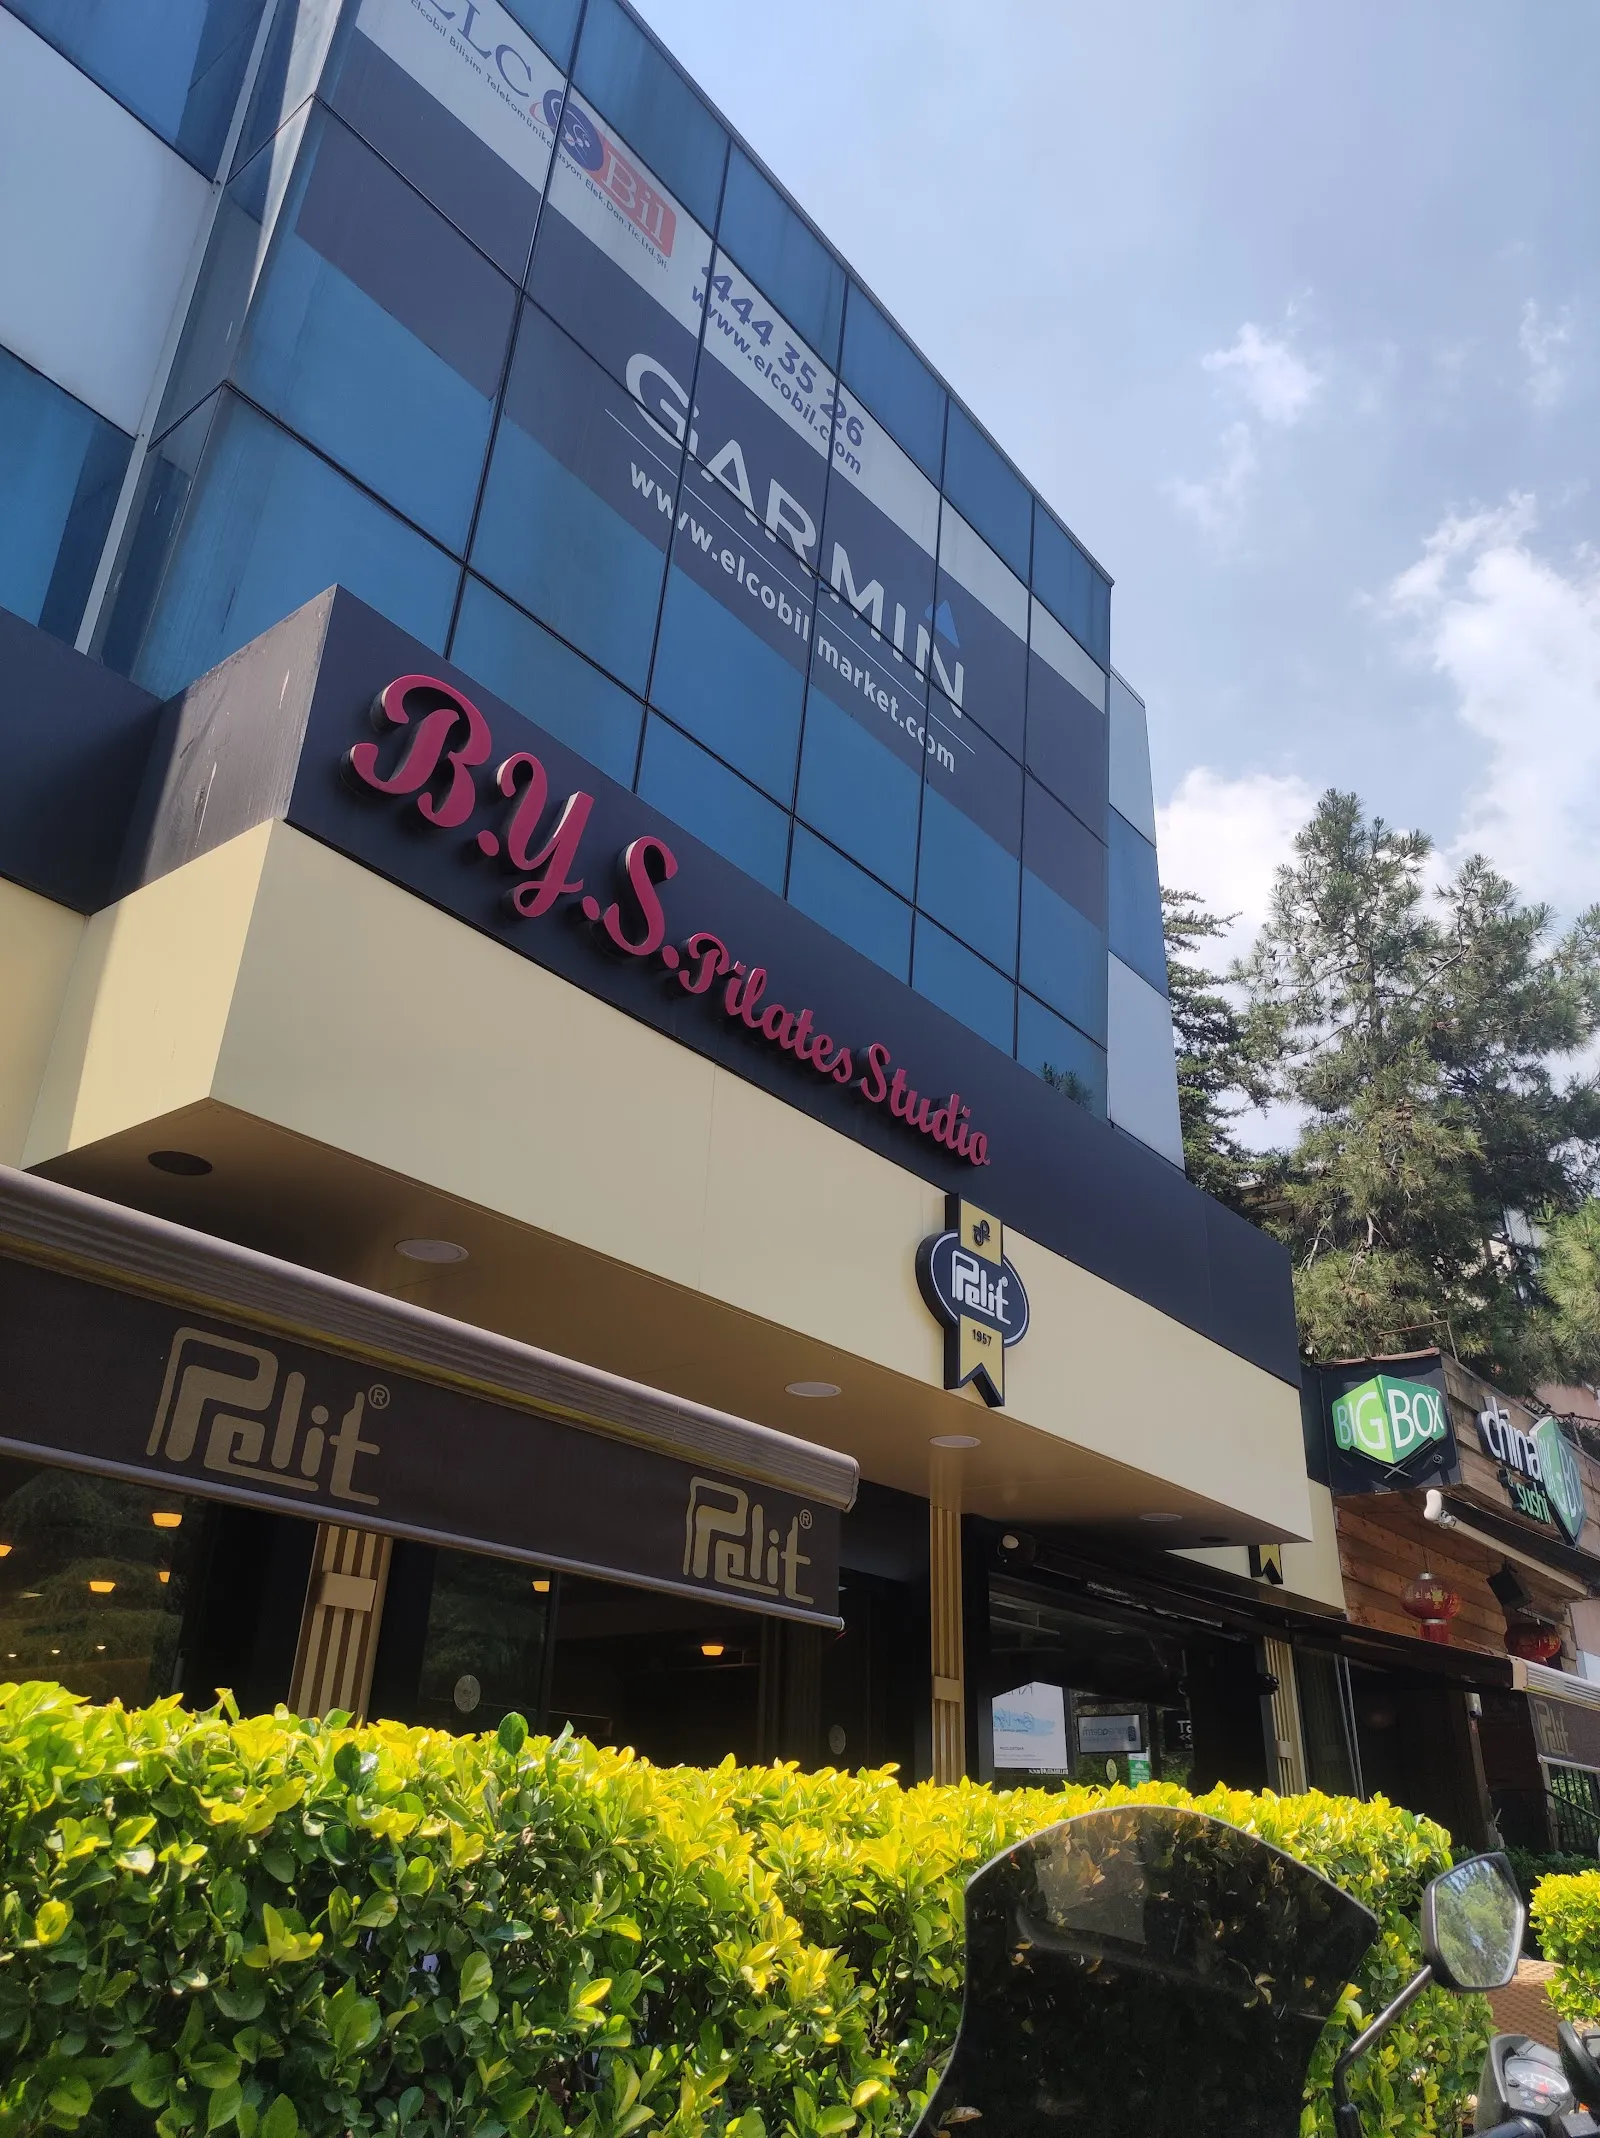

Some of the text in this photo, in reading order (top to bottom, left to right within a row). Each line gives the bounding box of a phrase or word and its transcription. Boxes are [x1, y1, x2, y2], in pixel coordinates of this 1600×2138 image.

[778, 341, 817, 394] 35
[820, 388, 865, 447] 26
[625, 353, 964, 718] GARMIN
[860, 1043, 990, 1166] Studio
[972, 1328, 992, 1347] 1957
[1336, 1389, 1445, 1450] BIG BOX
[1515, 1481, 1552, 1525] sushi
